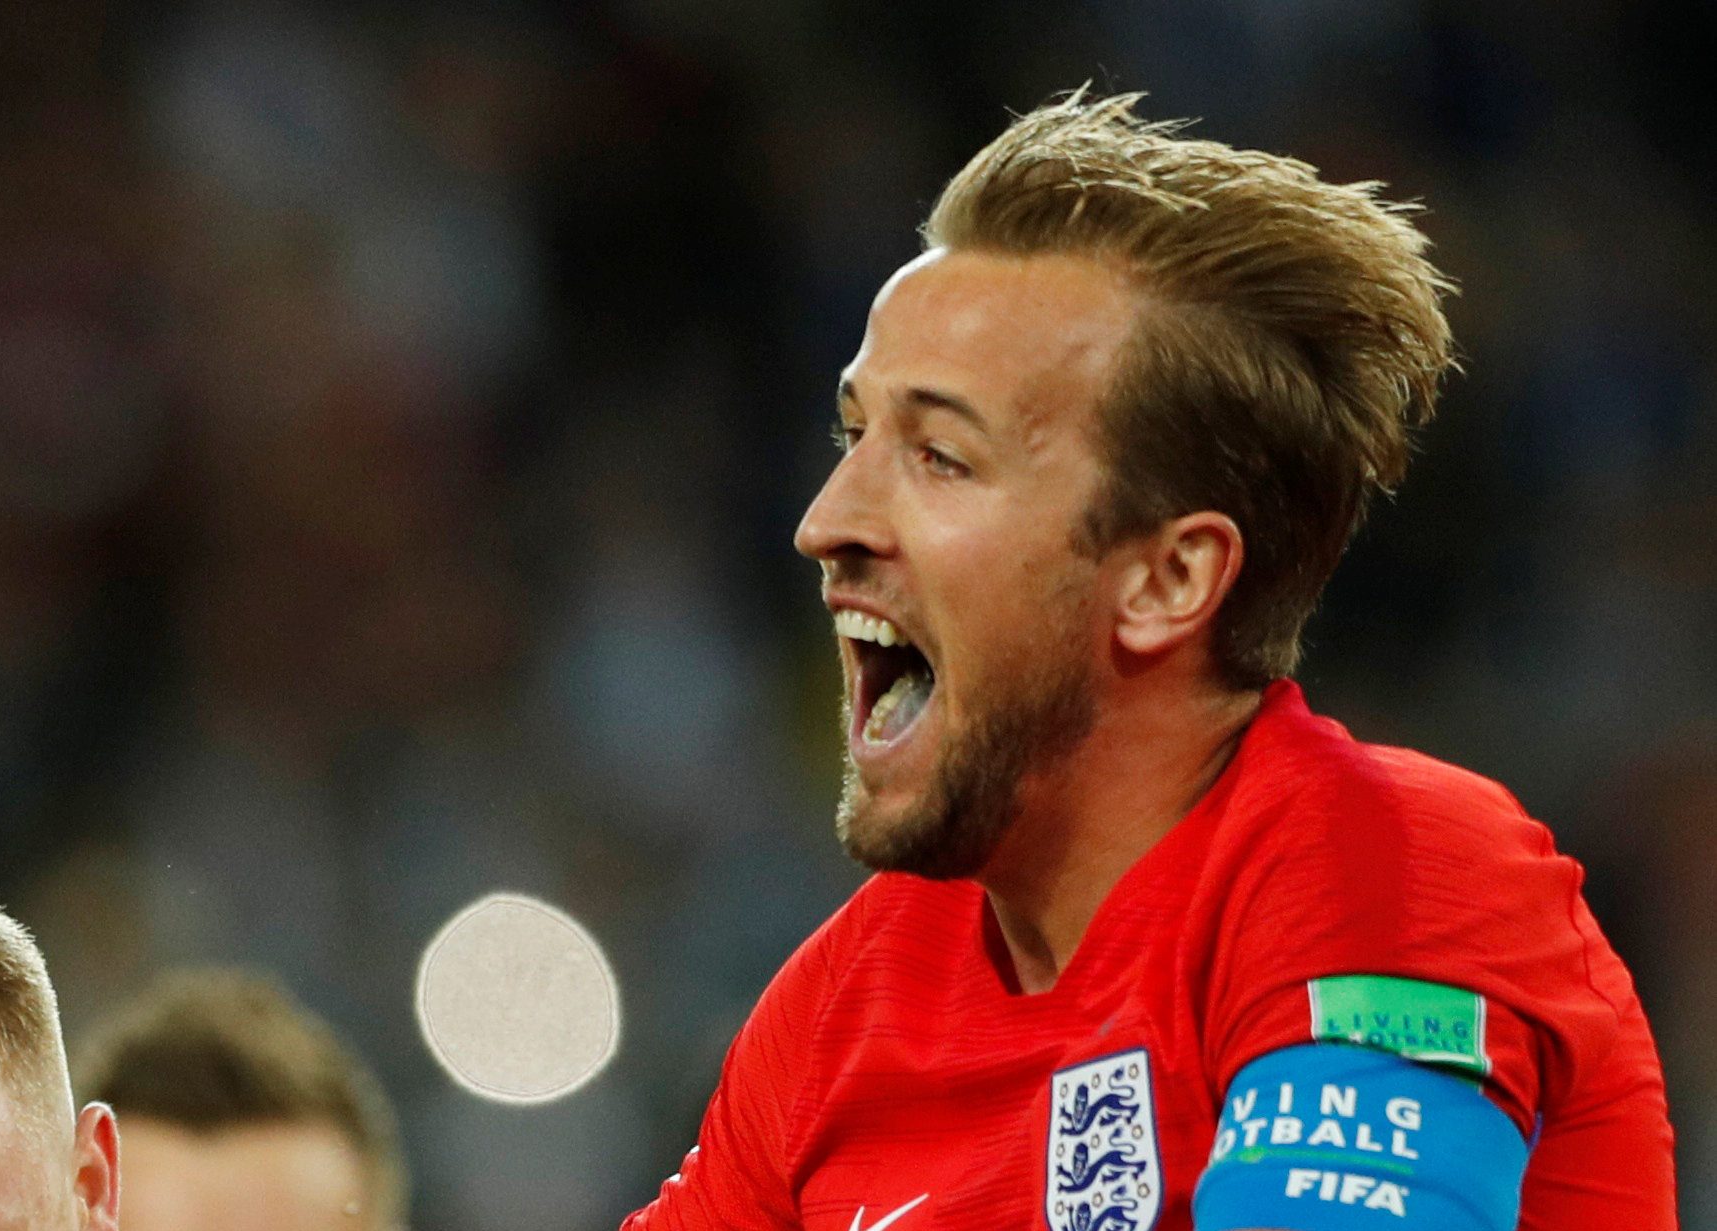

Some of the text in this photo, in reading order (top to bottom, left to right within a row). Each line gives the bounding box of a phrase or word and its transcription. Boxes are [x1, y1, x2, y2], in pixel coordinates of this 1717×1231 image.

[1327, 1012, 1469, 1039] LIVING
[1232, 1082, 1422, 1131] VING
[1212, 1116, 1420, 1161] OTBALL
[1284, 1168, 1406, 1218] FIFA
